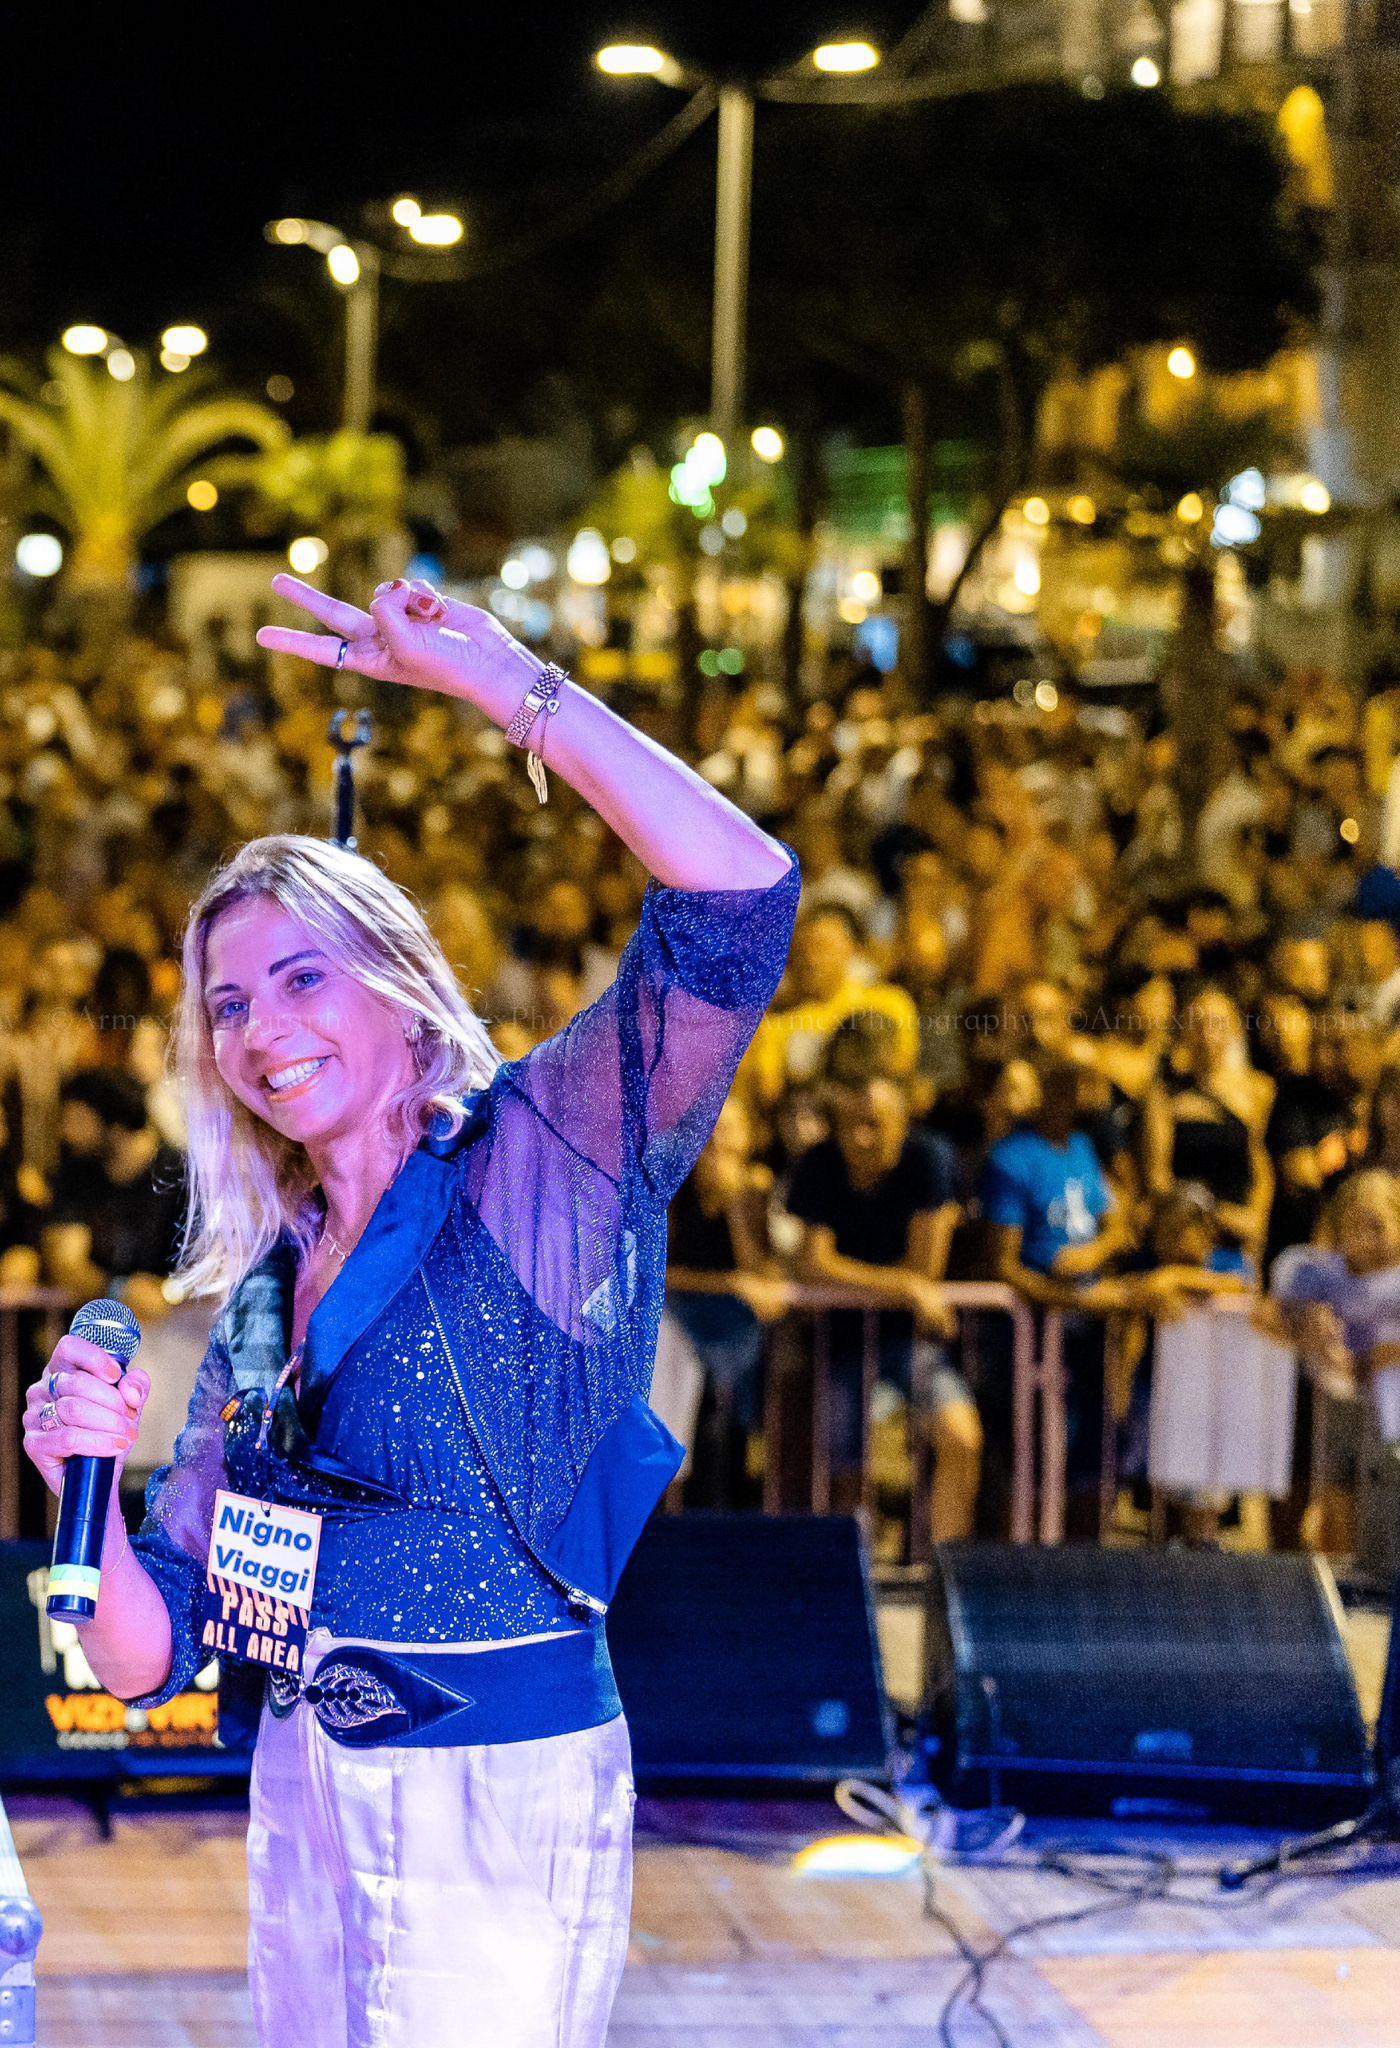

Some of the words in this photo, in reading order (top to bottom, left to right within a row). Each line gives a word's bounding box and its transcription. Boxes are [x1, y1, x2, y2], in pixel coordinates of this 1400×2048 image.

[219, 1505, 312, 1551] Nigno
[216, 1544, 310, 1593] Viaggi
[221, 1591, 289, 1637] PASS
[202, 1619, 238, 1654] ALL
[246, 1632, 299, 1672] AREA
